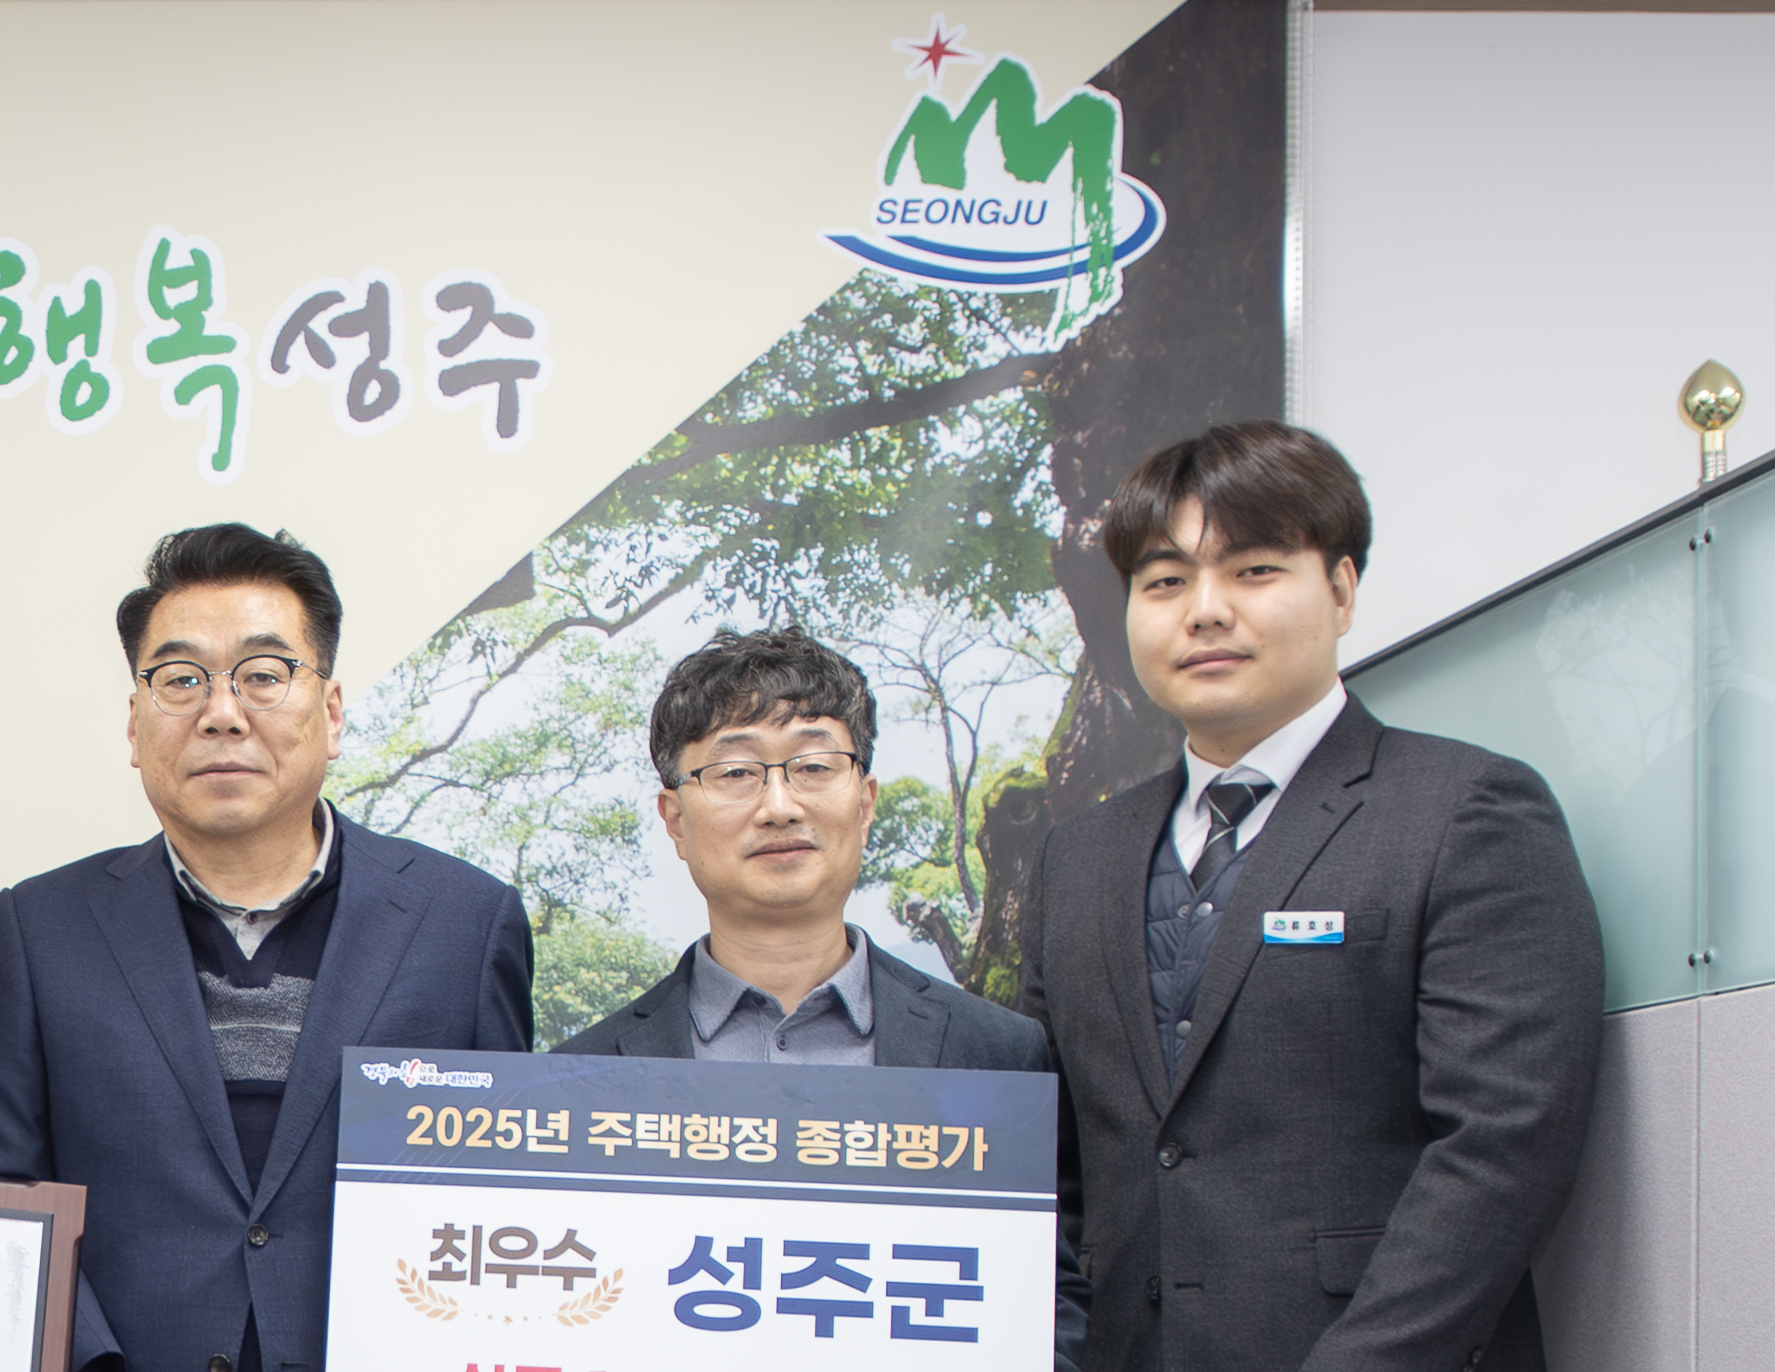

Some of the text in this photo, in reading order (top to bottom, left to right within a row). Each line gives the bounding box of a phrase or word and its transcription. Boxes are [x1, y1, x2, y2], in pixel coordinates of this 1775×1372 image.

[876, 197, 1049, 226] SEONGJU
[445, 1073, 492, 1087] 대한민국
[405, 1104, 989, 1172] 2025년 주택행정 종합평가
[428, 1222, 598, 1292] 최우수
[667, 1234, 985, 1344] 성주군
